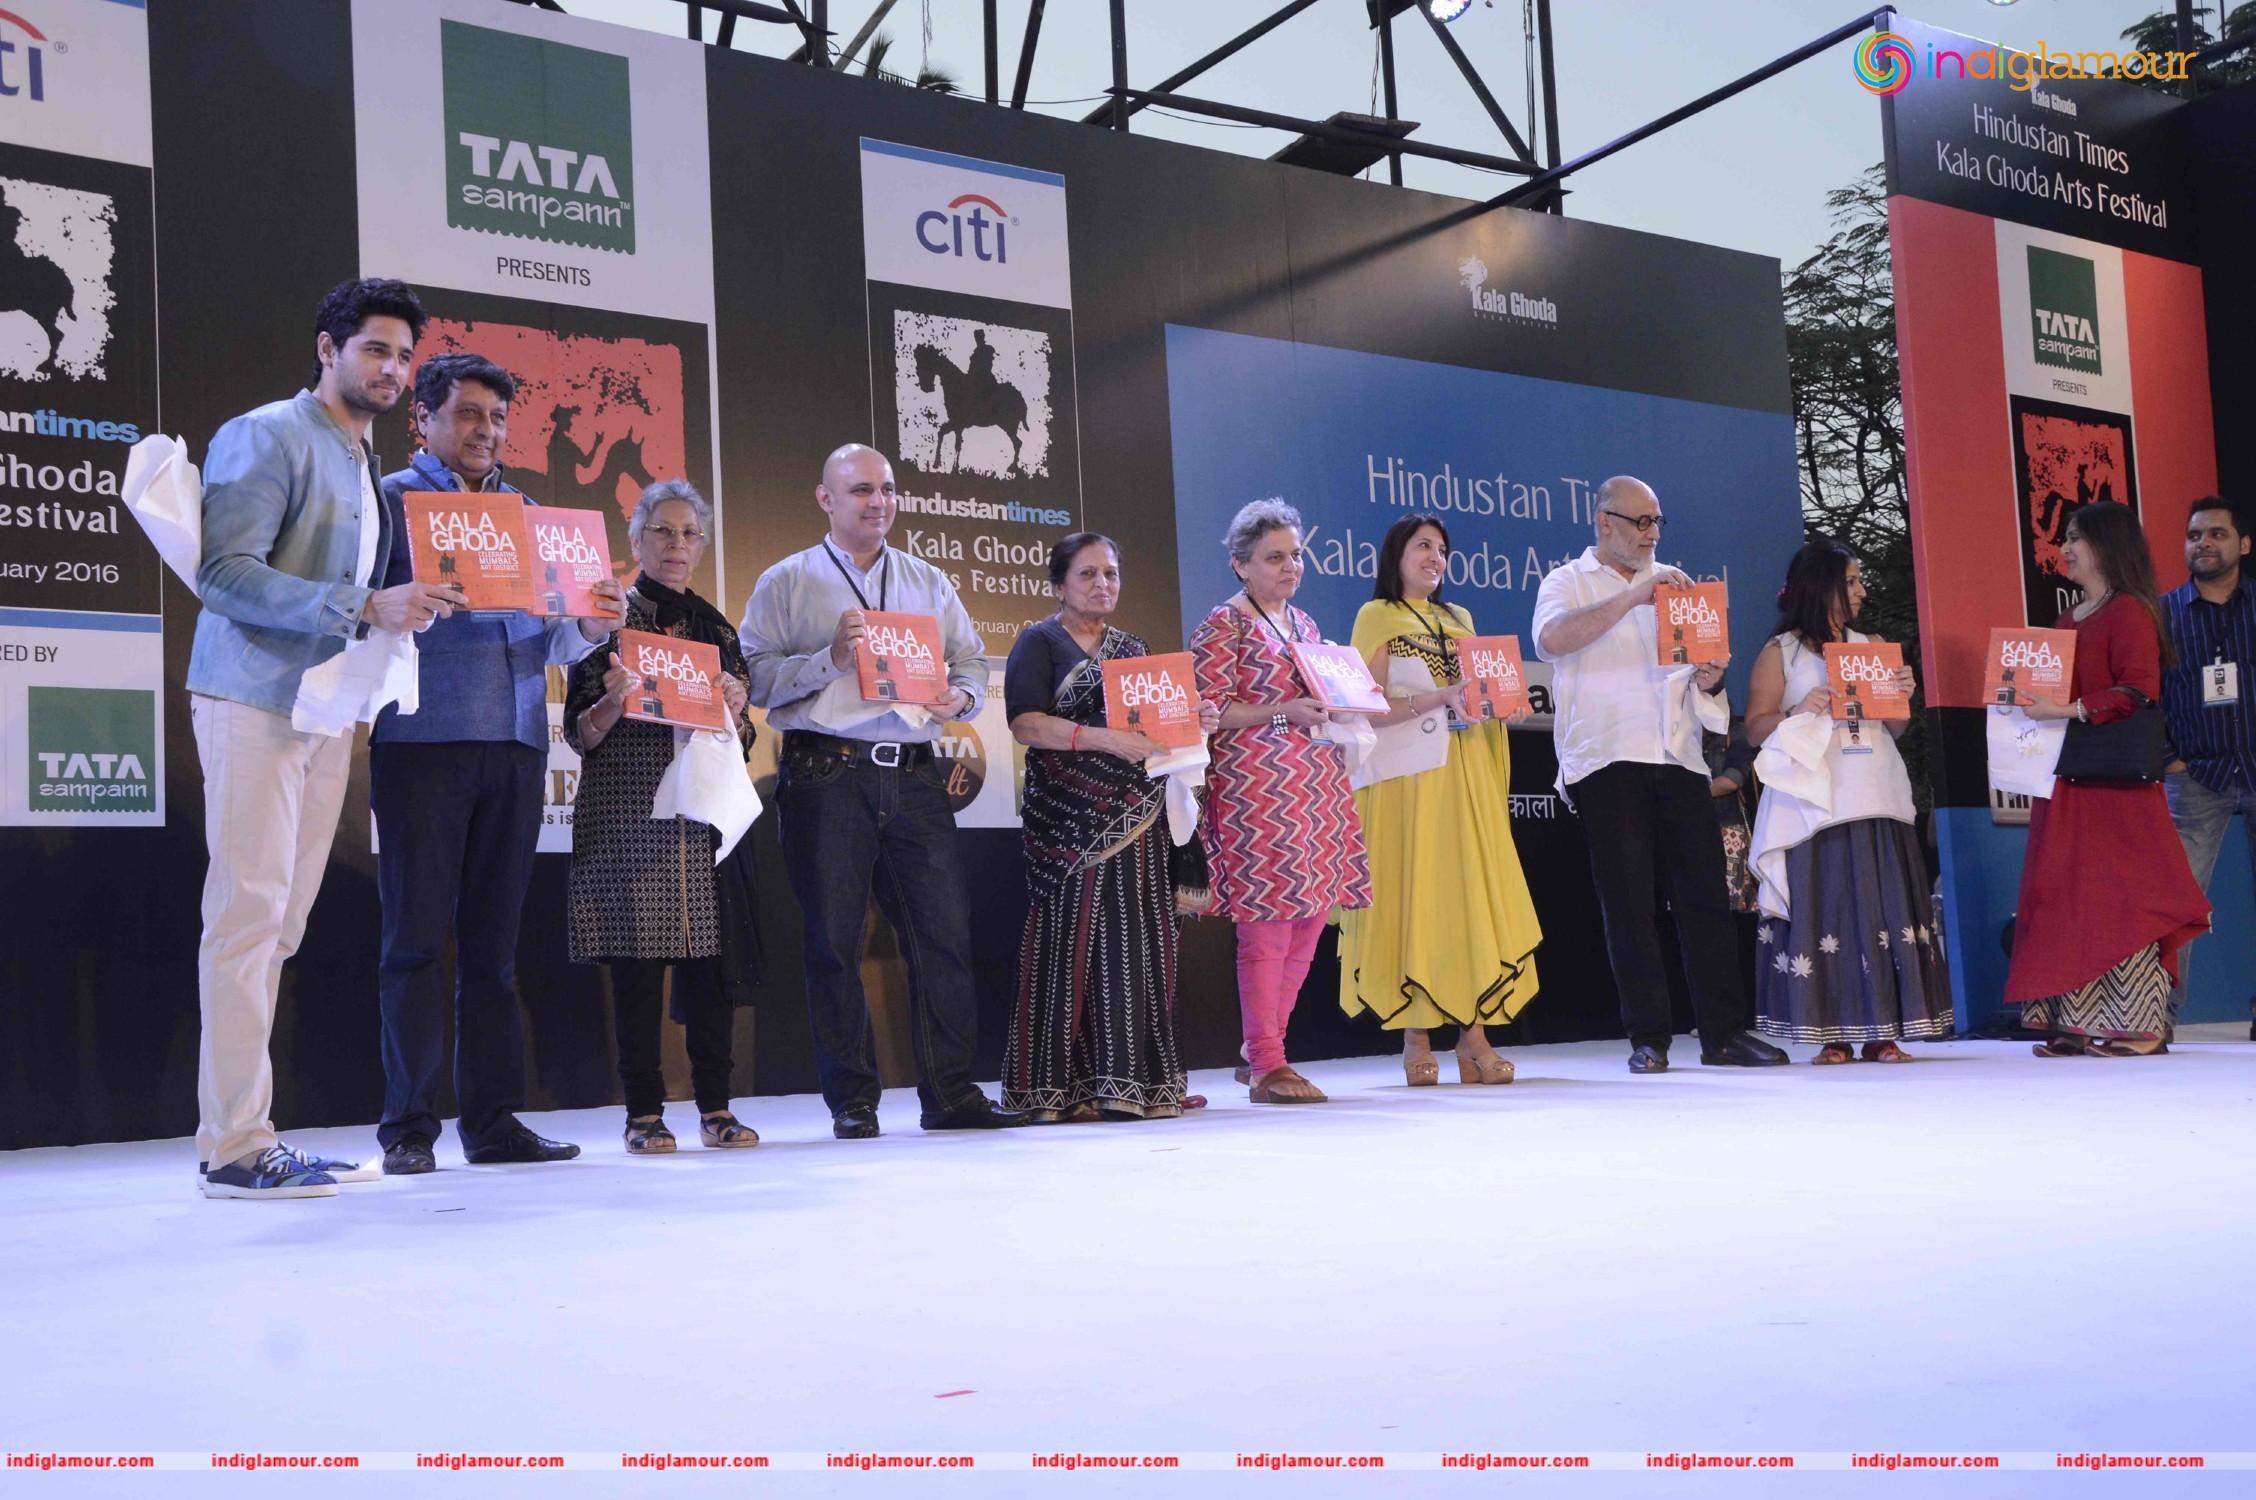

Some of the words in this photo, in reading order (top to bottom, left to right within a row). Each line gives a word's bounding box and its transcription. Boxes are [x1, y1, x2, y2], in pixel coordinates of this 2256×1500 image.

[1973, 103, 2070, 158] Hindustan
[2074, 130, 2128, 174] Times
[459, 131, 620, 200] TATA
[1936, 140, 1980, 180] Kala
[1986, 154, 2049, 198] Ghoda
[2053, 171, 2093, 210] Arts
[2098, 183, 2167, 228] Festival
[461, 184, 622, 229] sampann
[915, 206, 1007, 264] citi
[496, 256, 591, 287] PRESENTS
[1472, 286, 1507, 315] Kala
[1510, 291, 1557, 323] Ghoda
[2035, 308, 2095, 344] TATA
[2038, 338, 2097, 362] sampann
[2052, 379, 2088, 396] PRESENTS
[1367, 454, 1552, 521] Hindustan
[428, 511, 497, 532] KALA
[431, 530, 516, 552] GHODA
[535, 524, 586, 546] KALA
[905, 530, 964, 561] Kala
[538, 542, 601, 565] GHODA
[55, 562, 119, 583] 2016
[1668, 596, 1708, 612] KALA
[1670, 609, 1719, 625] GHODA
[866, 625, 917, 644] KALA
[35, 647, 58, 662] BY
[638, 644, 695, 670] KALA
[869, 640, 933, 660] GHODA
[1472, 650, 1506, 665] KALA
[2002, 640, 2051, 655] KALA
[1474, 662, 1518, 679] GHODA
[1839, 655, 1883, 669] KALA
[2001, 653, 2063, 669] GHODA
[639, 659, 711, 686] GHODA
[1120, 670, 1172, 692] KALA
[1841, 668, 1894, 681] GHODA
[1122, 684, 1188, 707] GHODA
[38, 752, 147, 779] TATA
[39, 783, 147, 804] sampann
